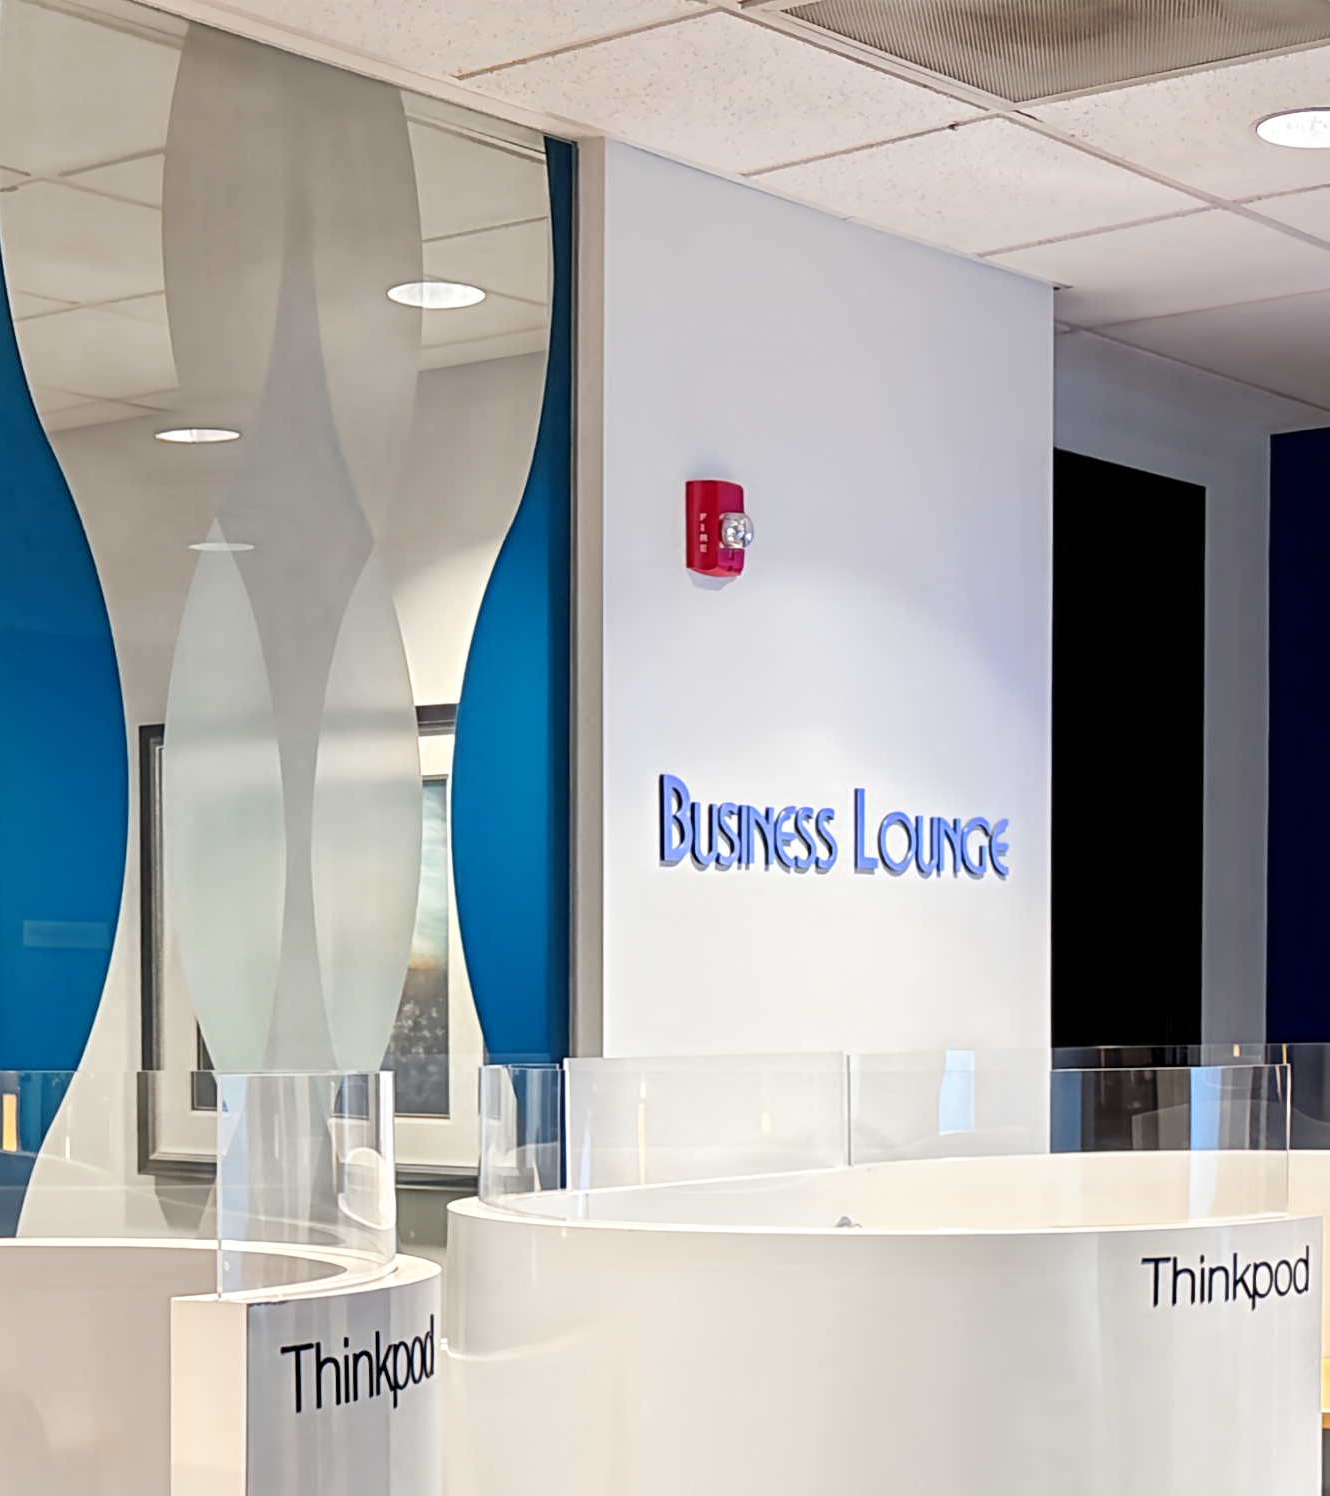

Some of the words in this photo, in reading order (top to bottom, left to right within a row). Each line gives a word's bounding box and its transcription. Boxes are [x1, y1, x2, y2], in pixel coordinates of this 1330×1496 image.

[699, 512, 708, 553] FIRE
[1141, 1245, 1310, 1312] Thinkpod
[280, 1313, 435, 1414] Thinkpod
